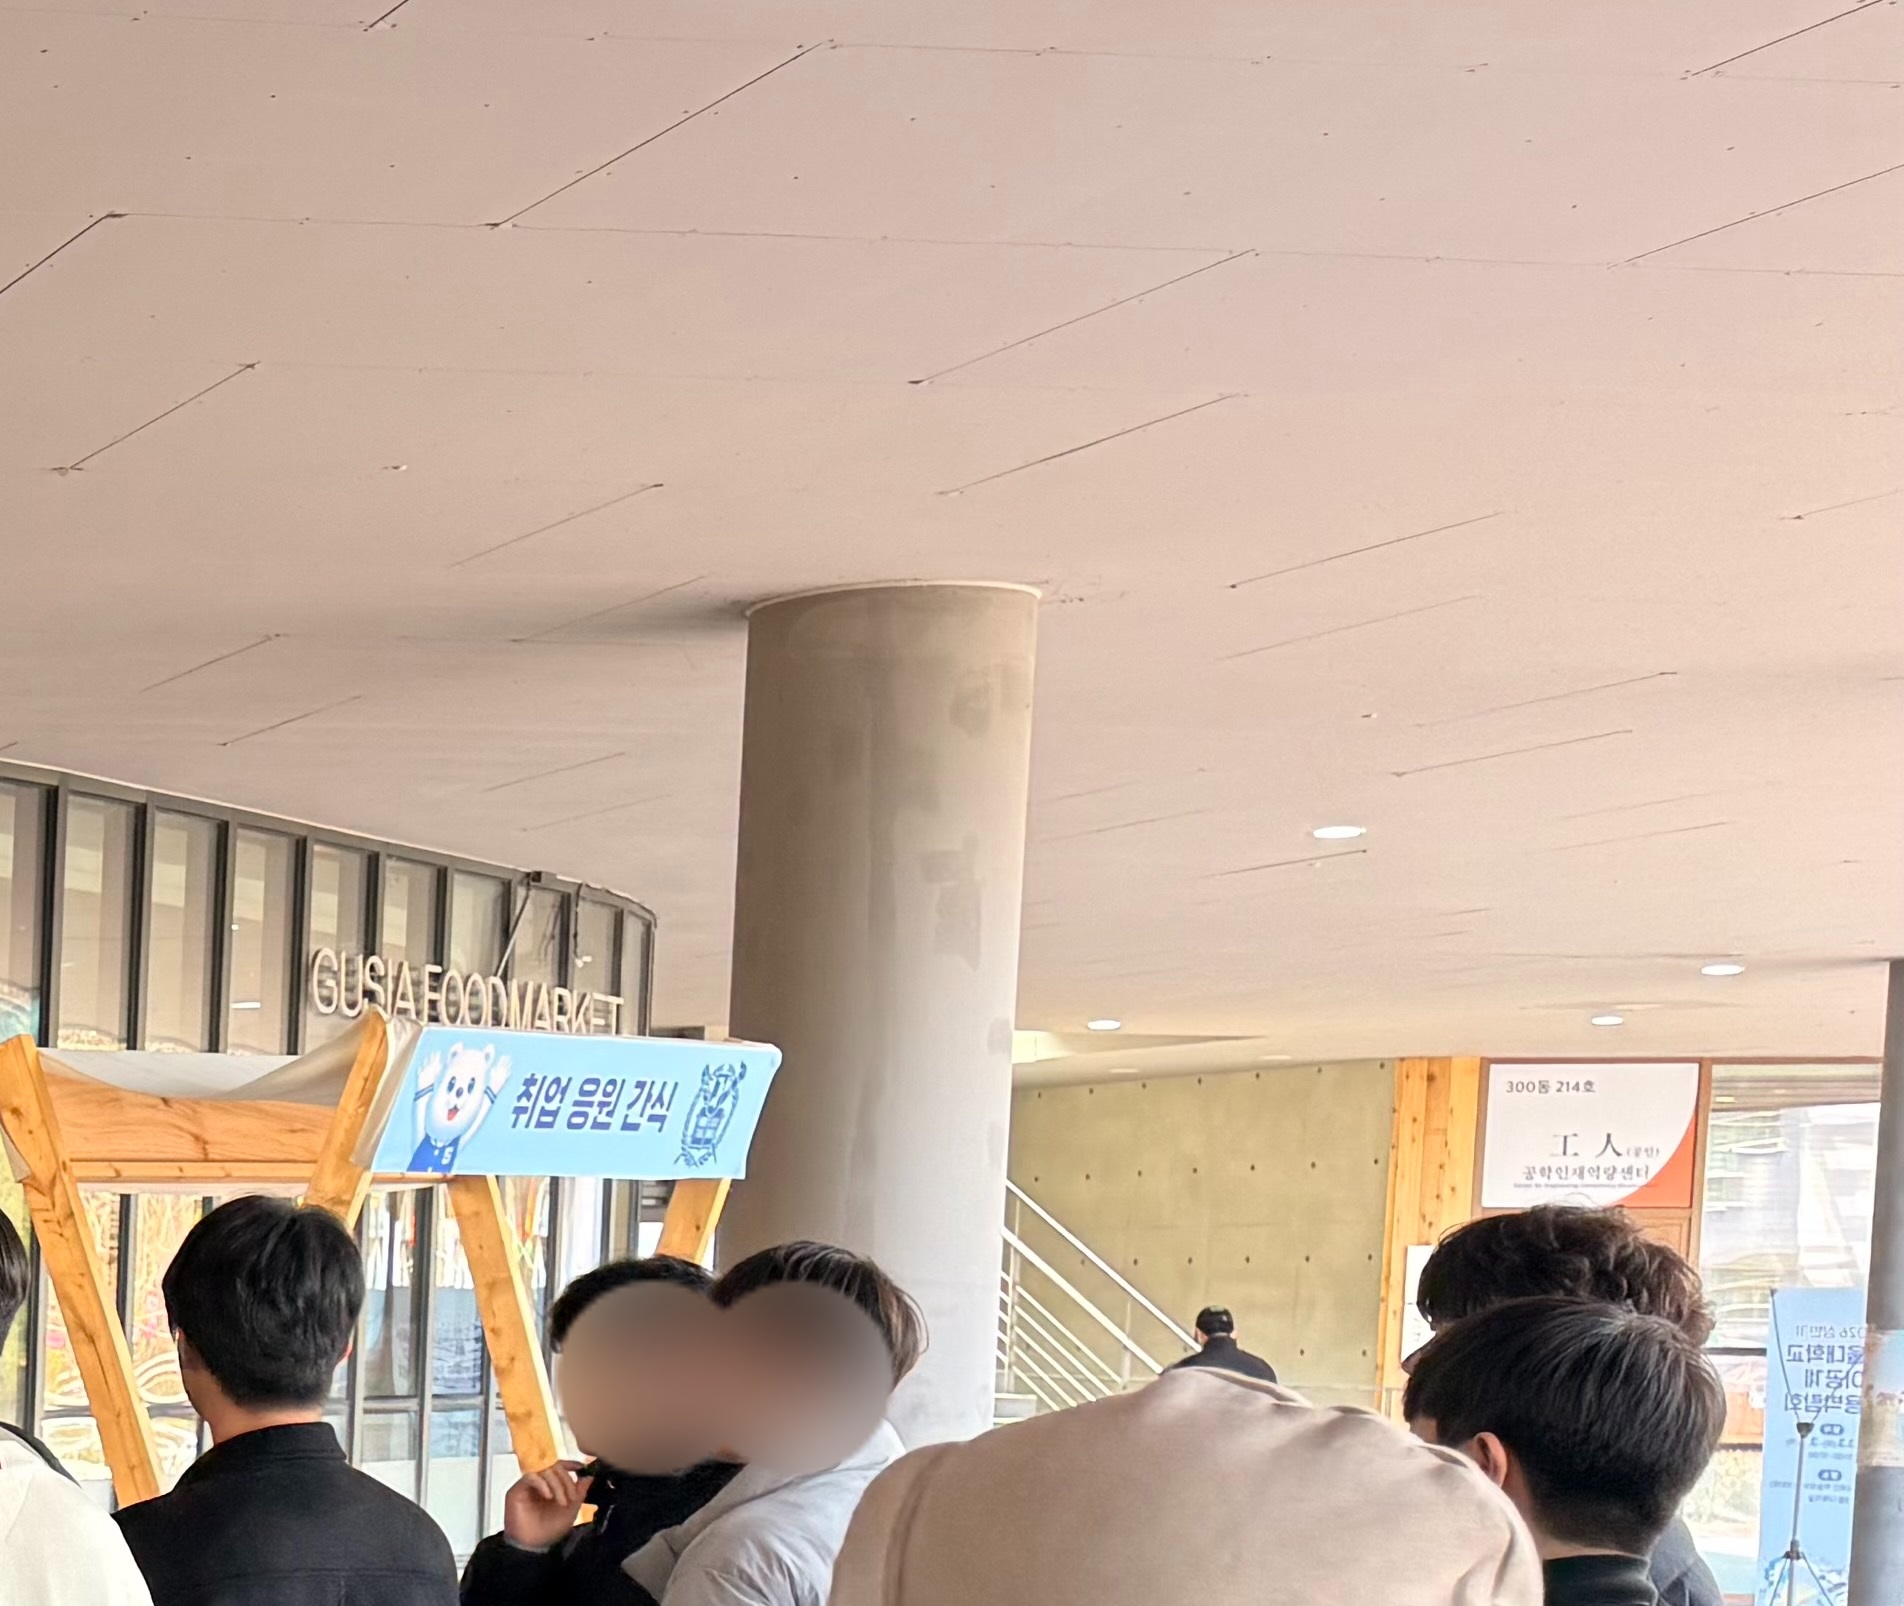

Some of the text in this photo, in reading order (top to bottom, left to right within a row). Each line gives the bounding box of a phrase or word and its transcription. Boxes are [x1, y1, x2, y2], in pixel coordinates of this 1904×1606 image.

[312, 947, 625, 1036] GUSIA FOOD MARKET
[510, 1072, 679, 1134] 취업 응원 간식
[1506, 1080, 1596, 1095] 300동 214호
